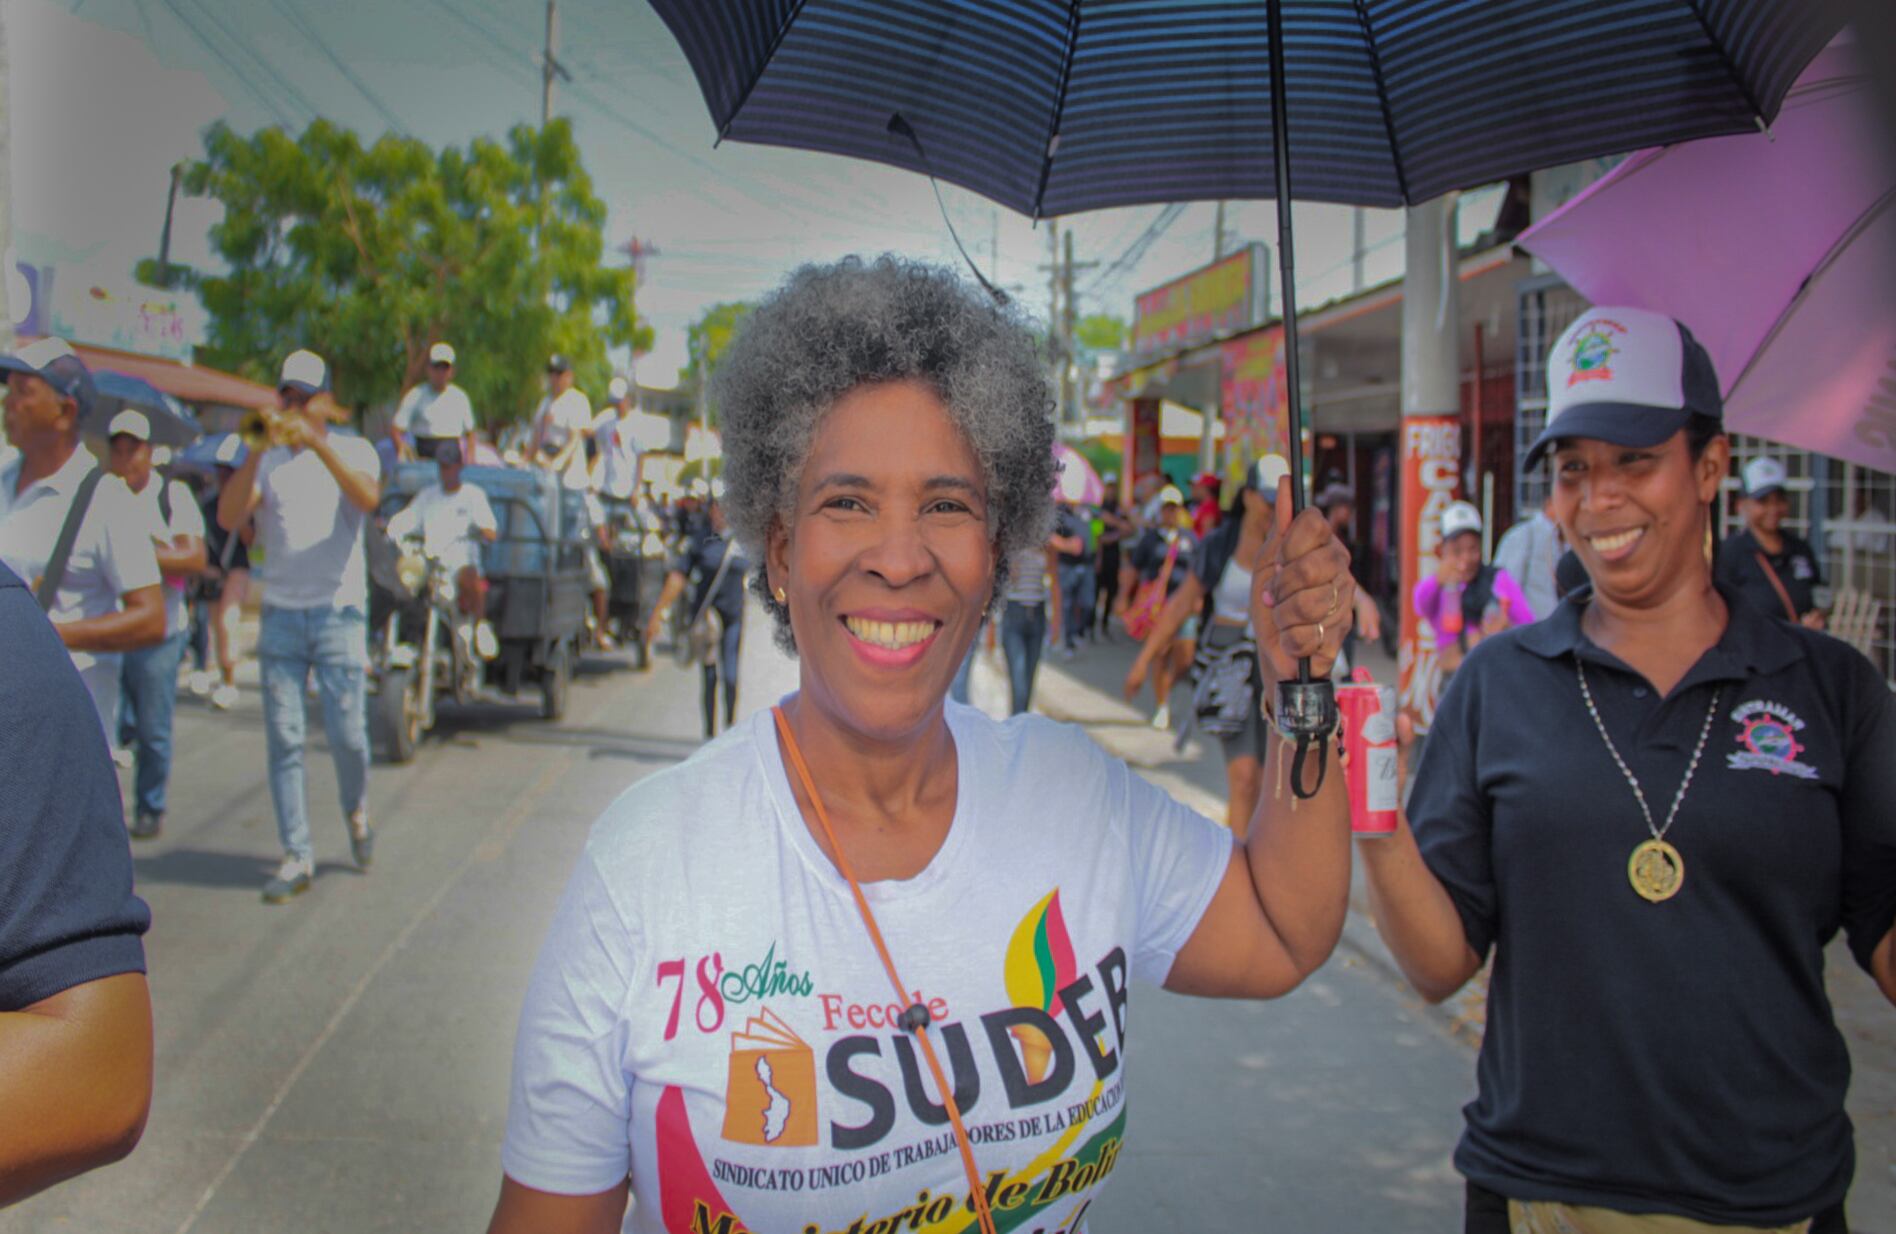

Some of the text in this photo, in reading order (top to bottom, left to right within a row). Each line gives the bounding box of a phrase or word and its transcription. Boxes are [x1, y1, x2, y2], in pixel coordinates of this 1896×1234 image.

[657, 939, 814, 1041] 78 Años
[713, 1158, 805, 1192] SINDICATO
[809, 1160, 866, 1191] UNICO
[868, 1152, 892, 1178] DE
[894, 1121, 1016, 1170] TRABAJAORES
[1019, 1116, 1043, 1139] DE
[1045, 1110, 1066, 1134] LA
[689, 1188, 956, 1234] Mterio
[966, 1168, 1031, 1213] de
